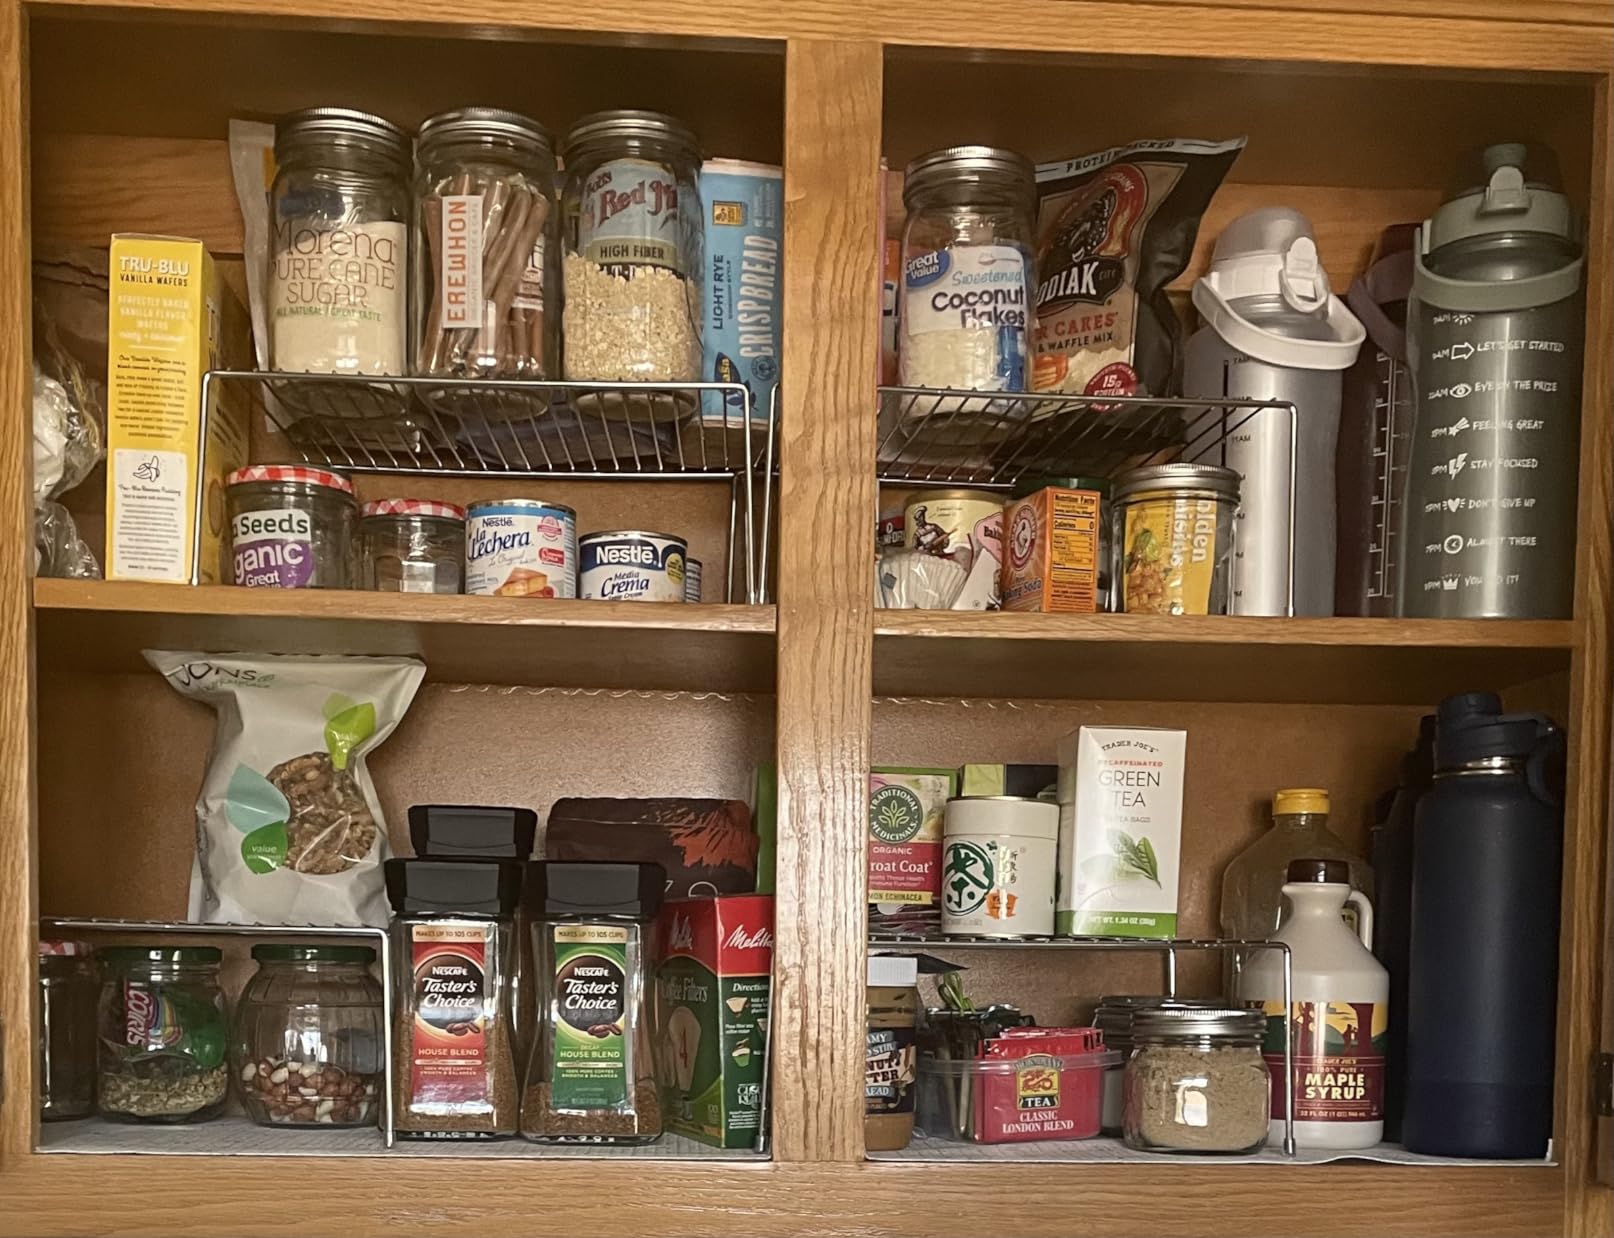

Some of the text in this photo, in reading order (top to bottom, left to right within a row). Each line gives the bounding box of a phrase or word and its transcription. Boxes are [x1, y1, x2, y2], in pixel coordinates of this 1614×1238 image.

[270, 220, 395, 266] Morena
[600, 245, 665, 260] HIGH FIBER
[120, 256, 190, 277] TRU-BLU
[447, 201, 467, 321] EREWHON
[905, 251, 939, 273] Great
[328, 258, 395, 291] CANE
[911, 264, 939, 280] Value
[952, 268, 1023, 287] Sweetened
[120, 273, 189, 288] VANILLA WAFERS
[1036, 261, 1099, 306] ODIAK
[286, 281, 368, 309] SUGAR
[712, 254, 724, 330] LIGHT RYE
[737, 235, 778, 358] CRISPBREAD
[931, 286, 1024, 312] Coconut
[961, 304, 1025, 329] Flakes
[1054, 313, 1115, 337] CAKES
[1047, 335, 1090, 350] WAFFLE
[1093, 331, 1113, 343] MIX
[1508, 340, 1527, 350] GET
[1528, 340, 1565, 353] STARTED
[1475, 381, 1494, 393] EYE
[1514, 380, 1532, 391] THE
[1534, 380, 1558, 392] PRIZE
[1472, 419, 1545, 431] FEELNG GREAT
[1470, 459, 1494, 470] STAY
[1498, 458, 1539, 469] FOCUSED
[1501, 498, 1522, 508] GIVE
[1524, 498, 1536, 508] UP
[240, 513, 308, 536] Seeds
[1191, 500, 1216, 563] olden
[467, 531, 530, 561] Lechera
[1466, 537, 1506, 548] ALMT
[1509, 536, 1537, 547] THERE
[234, 543, 304, 584] ganic
[246, 570, 281, 588] Great
[614, 571, 640, 581] Media
[601, 577, 650, 598] Crema
[174, 662, 257, 687] JONS
[1101, 740, 1156, 753] TRADER JOE'S
[1097, 760, 1163, 768] CAFFEINATED
[1098, 769, 1160, 787] GREEN
[870, 788, 919, 812] TRADITIONAL
[1112, 791, 1146, 808] TEA
[870, 820, 919, 843] MEDICINALS
[872, 846, 913, 855] ORGANIC
[870, 860, 929, 873] roat Coat
[415, 930, 435, 938] MAKES
[436, 930, 445, 938] UP
[466, 930, 482, 938] CUPS
[608, 931, 624, 939] CUPS
[422, 977, 478, 993] Taster's
[563, 978, 619, 994] Taster's
[733, 983, 769, 992] Directio
[424, 992, 476, 1008] Choice
[565, 994, 617, 1010] Choice
[866, 1033, 888, 1045] AMY
[418, 1048, 479, 1056] HOUSE BLEND
[867, 1070, 899, 1083] TER
[1305, 1073, 1365, 1087] MAPLE
[1305, 1086, 1366, 1100] SYRUP
[1024, 1097, 1052, 1108] TEA
[1019, 1110, 1058, 1122] CLASSIC
[1002, 1120, 1075, 1134] LONDON BLEND
